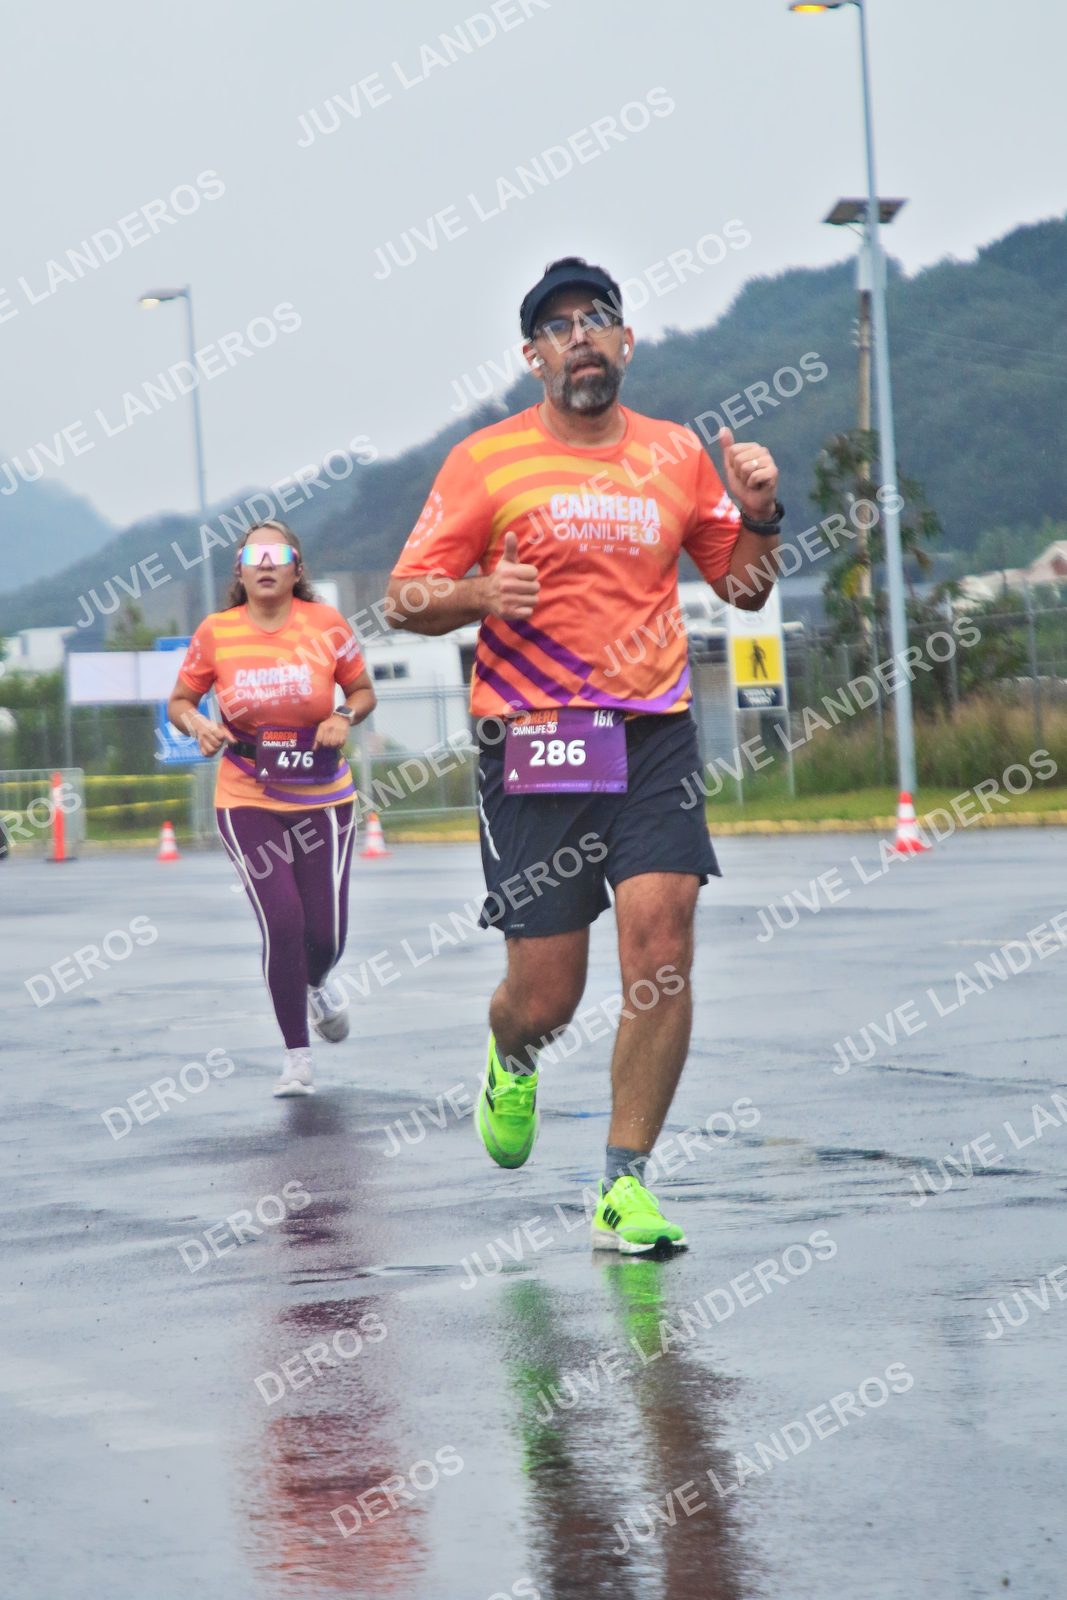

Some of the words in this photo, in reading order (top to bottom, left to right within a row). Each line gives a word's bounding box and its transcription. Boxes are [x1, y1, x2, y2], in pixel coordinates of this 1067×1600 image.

[551, 493, 660, 522] CARRERA
[235, 664, 311, 687] CARRERA
[263, 731, 298, 741] CARRERA
[277, 750, 314, 768] 476
[529, 739, 587, 767] 286
